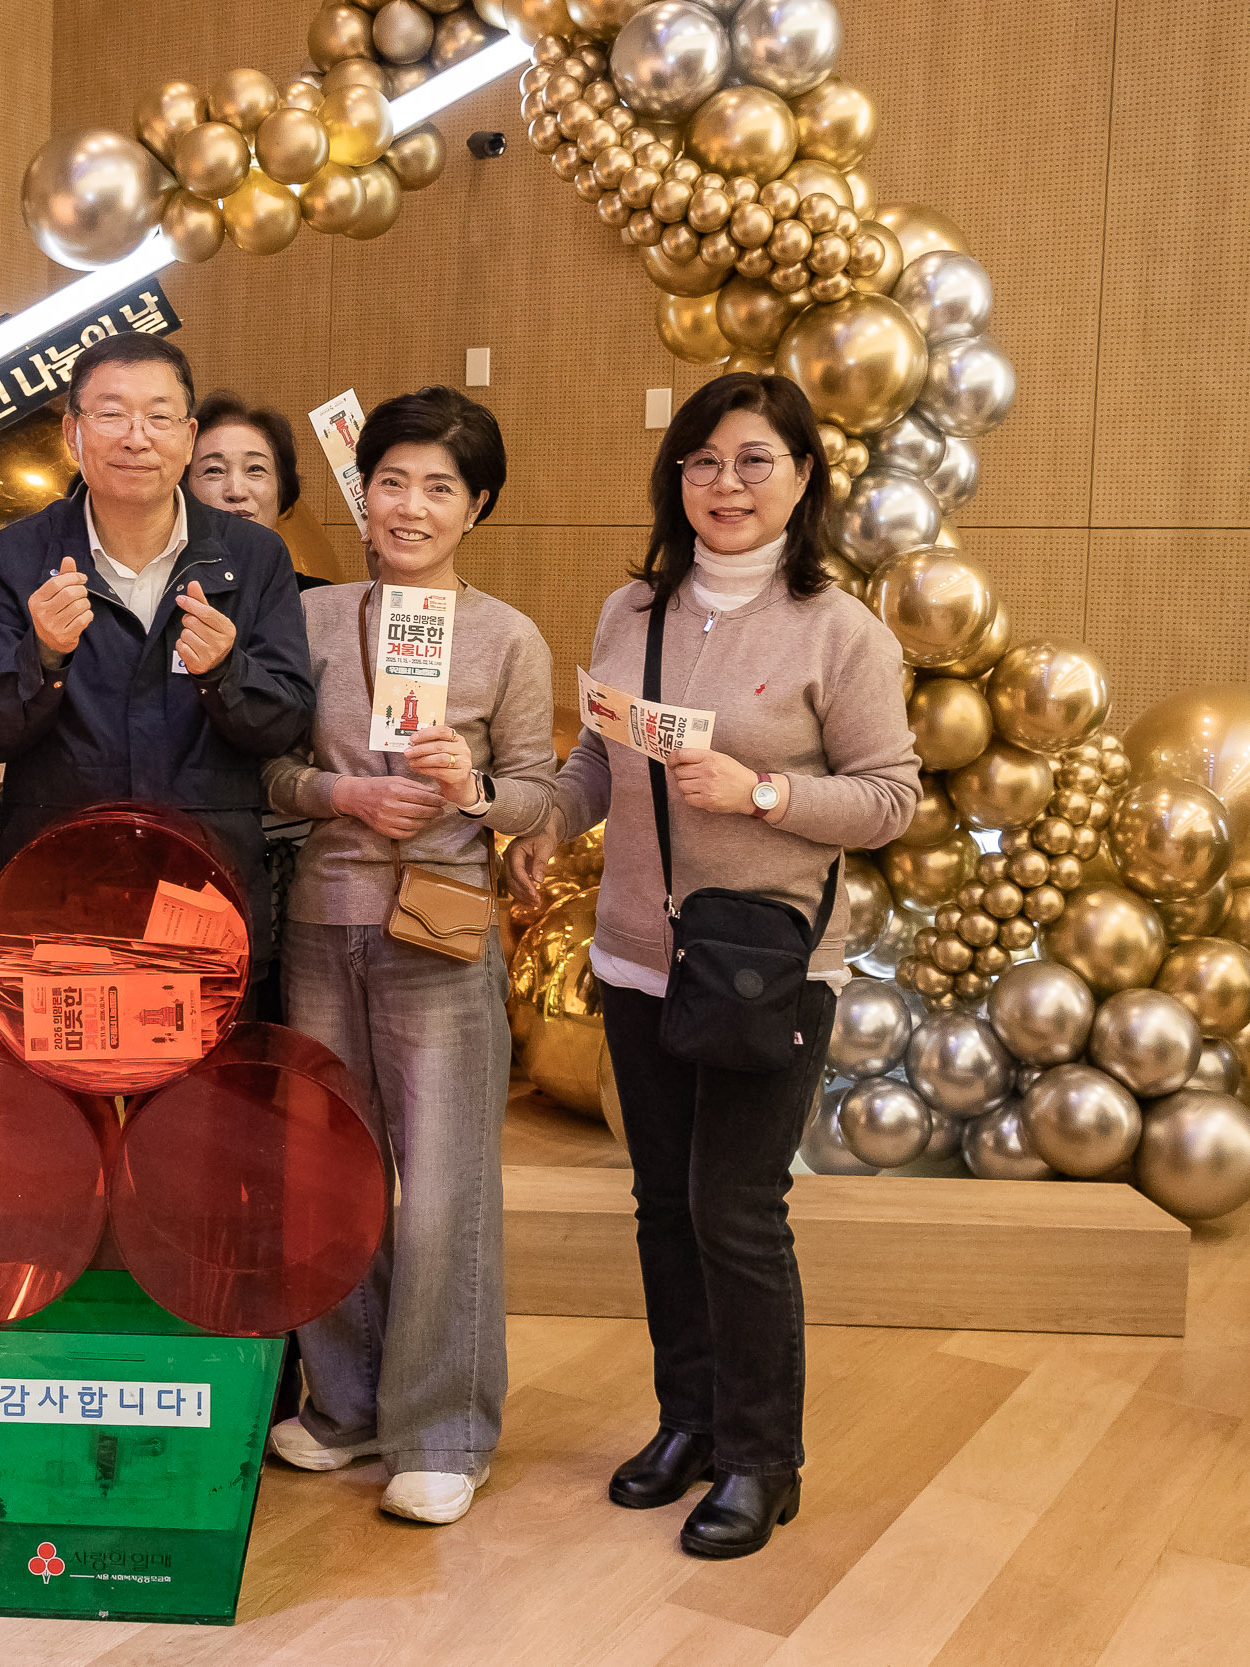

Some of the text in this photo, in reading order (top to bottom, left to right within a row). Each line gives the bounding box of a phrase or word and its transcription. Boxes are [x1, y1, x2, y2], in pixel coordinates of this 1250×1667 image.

[118, 291, 169, 334] 날
[390, 613, 411, 623] 2026
[388, 623, 445, 645] 따뜻한
[386, 642, 442, 659] 겨울나기
[676, 717, 688, 739] 2026
[63, 986, 84, 1051] 따뜻한
[54, 1026, 64, 1050] 2026
